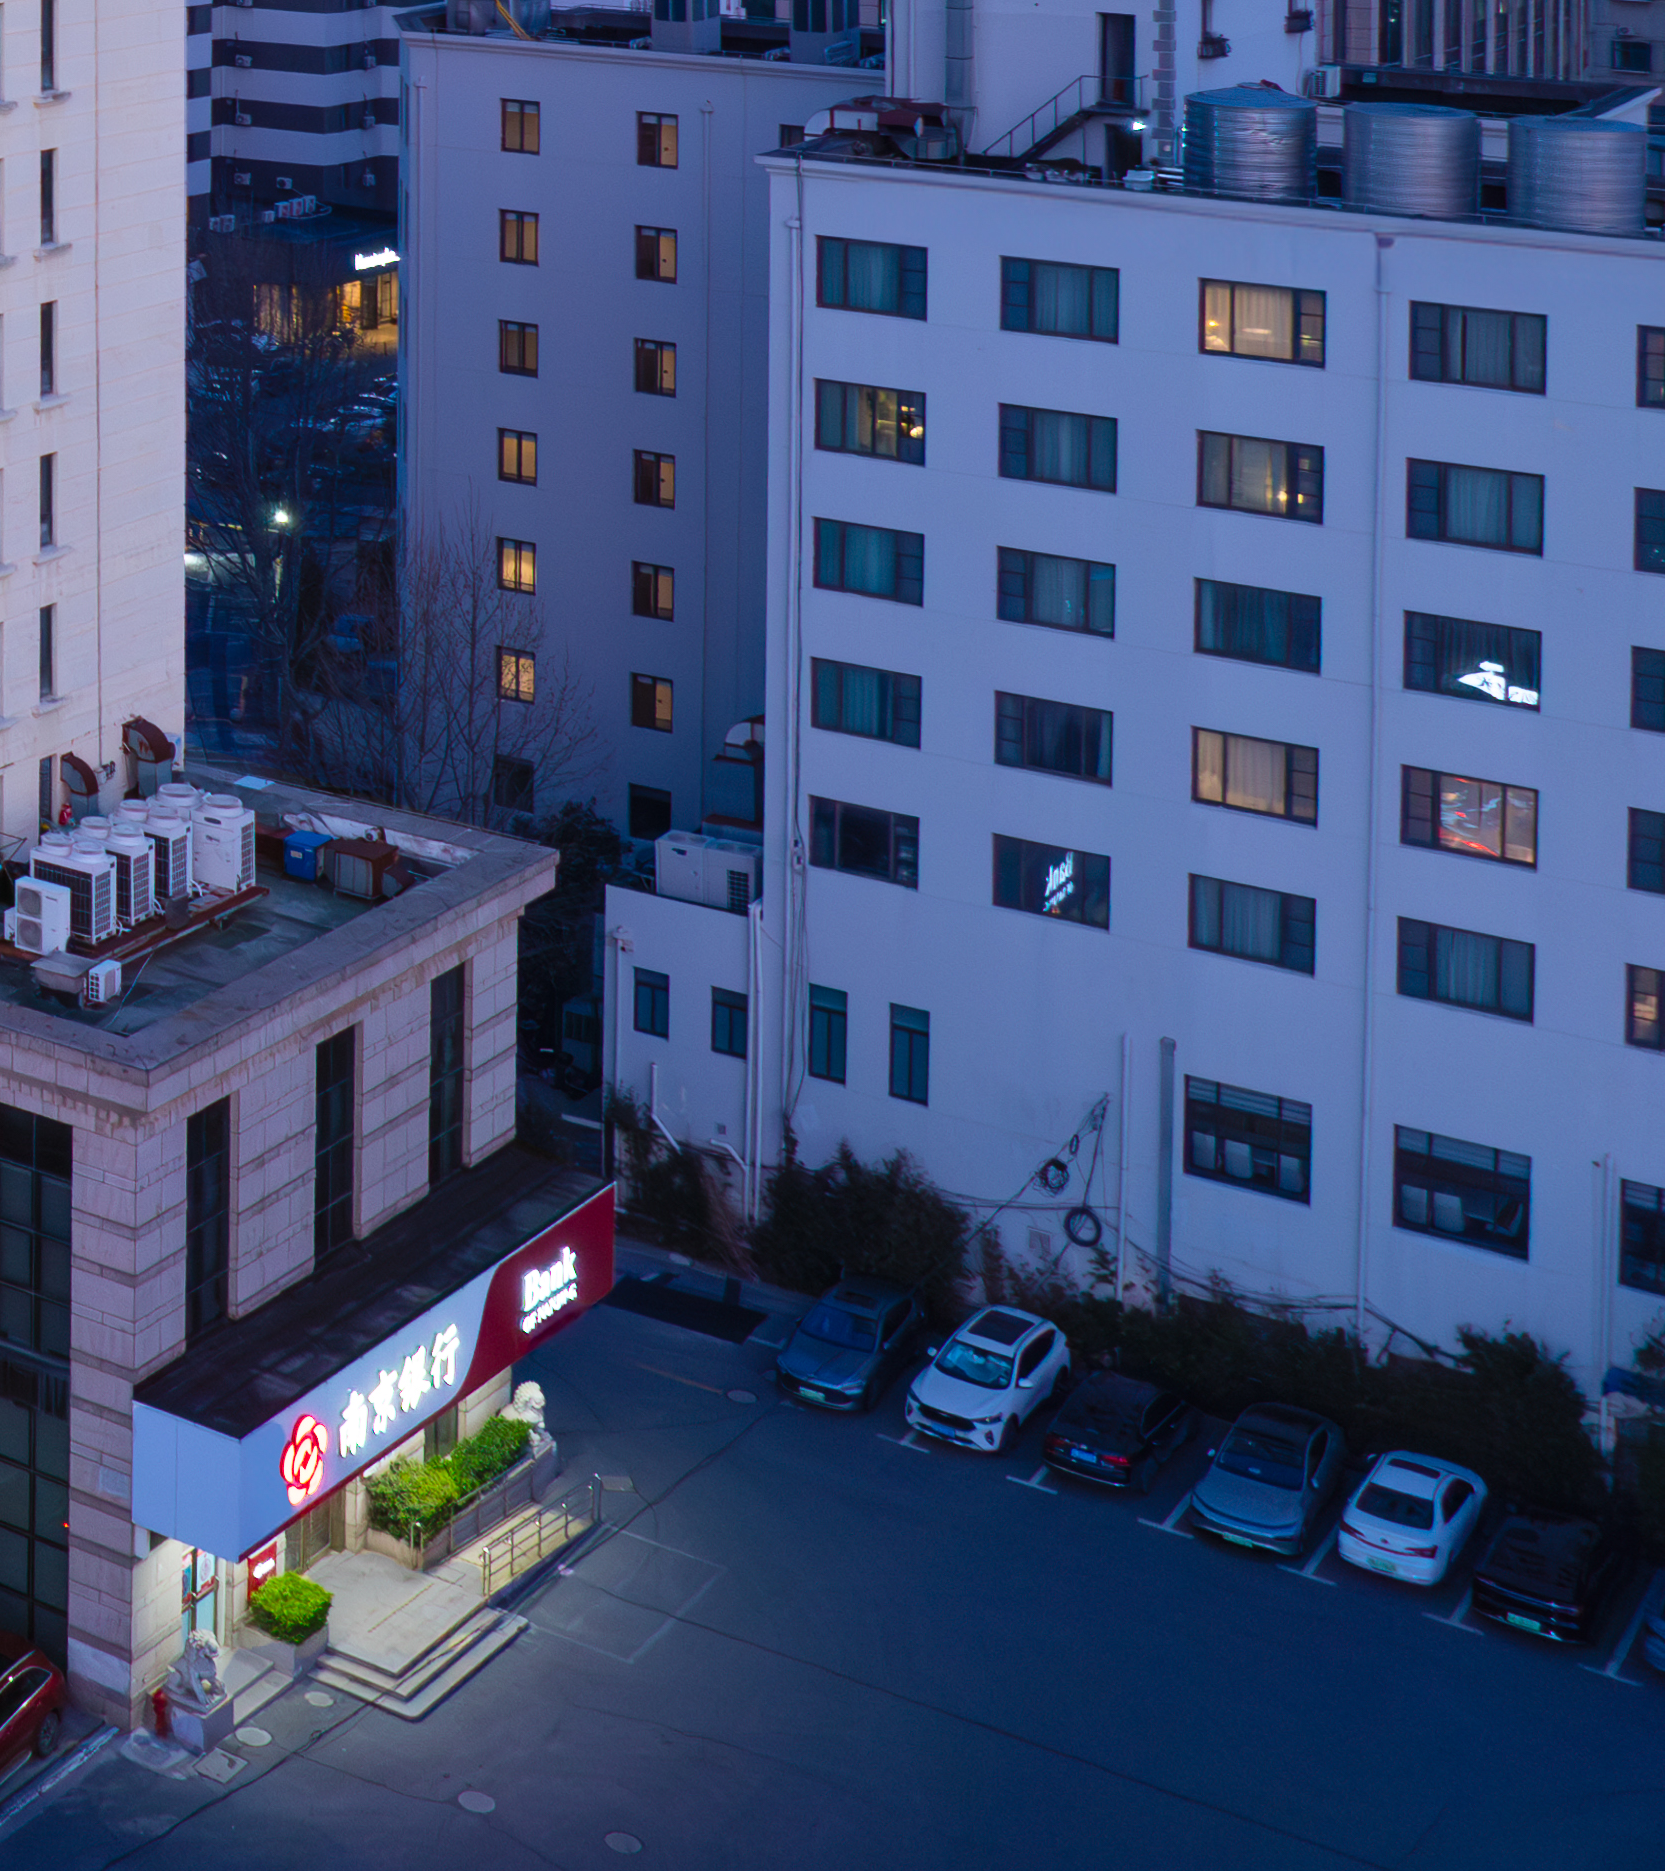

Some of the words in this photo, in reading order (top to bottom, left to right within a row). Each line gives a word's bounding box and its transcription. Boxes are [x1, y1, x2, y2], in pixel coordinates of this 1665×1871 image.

[523, 1246, 578, 1312] Bank
[339, 1323, 460, 1458] 南京银行
